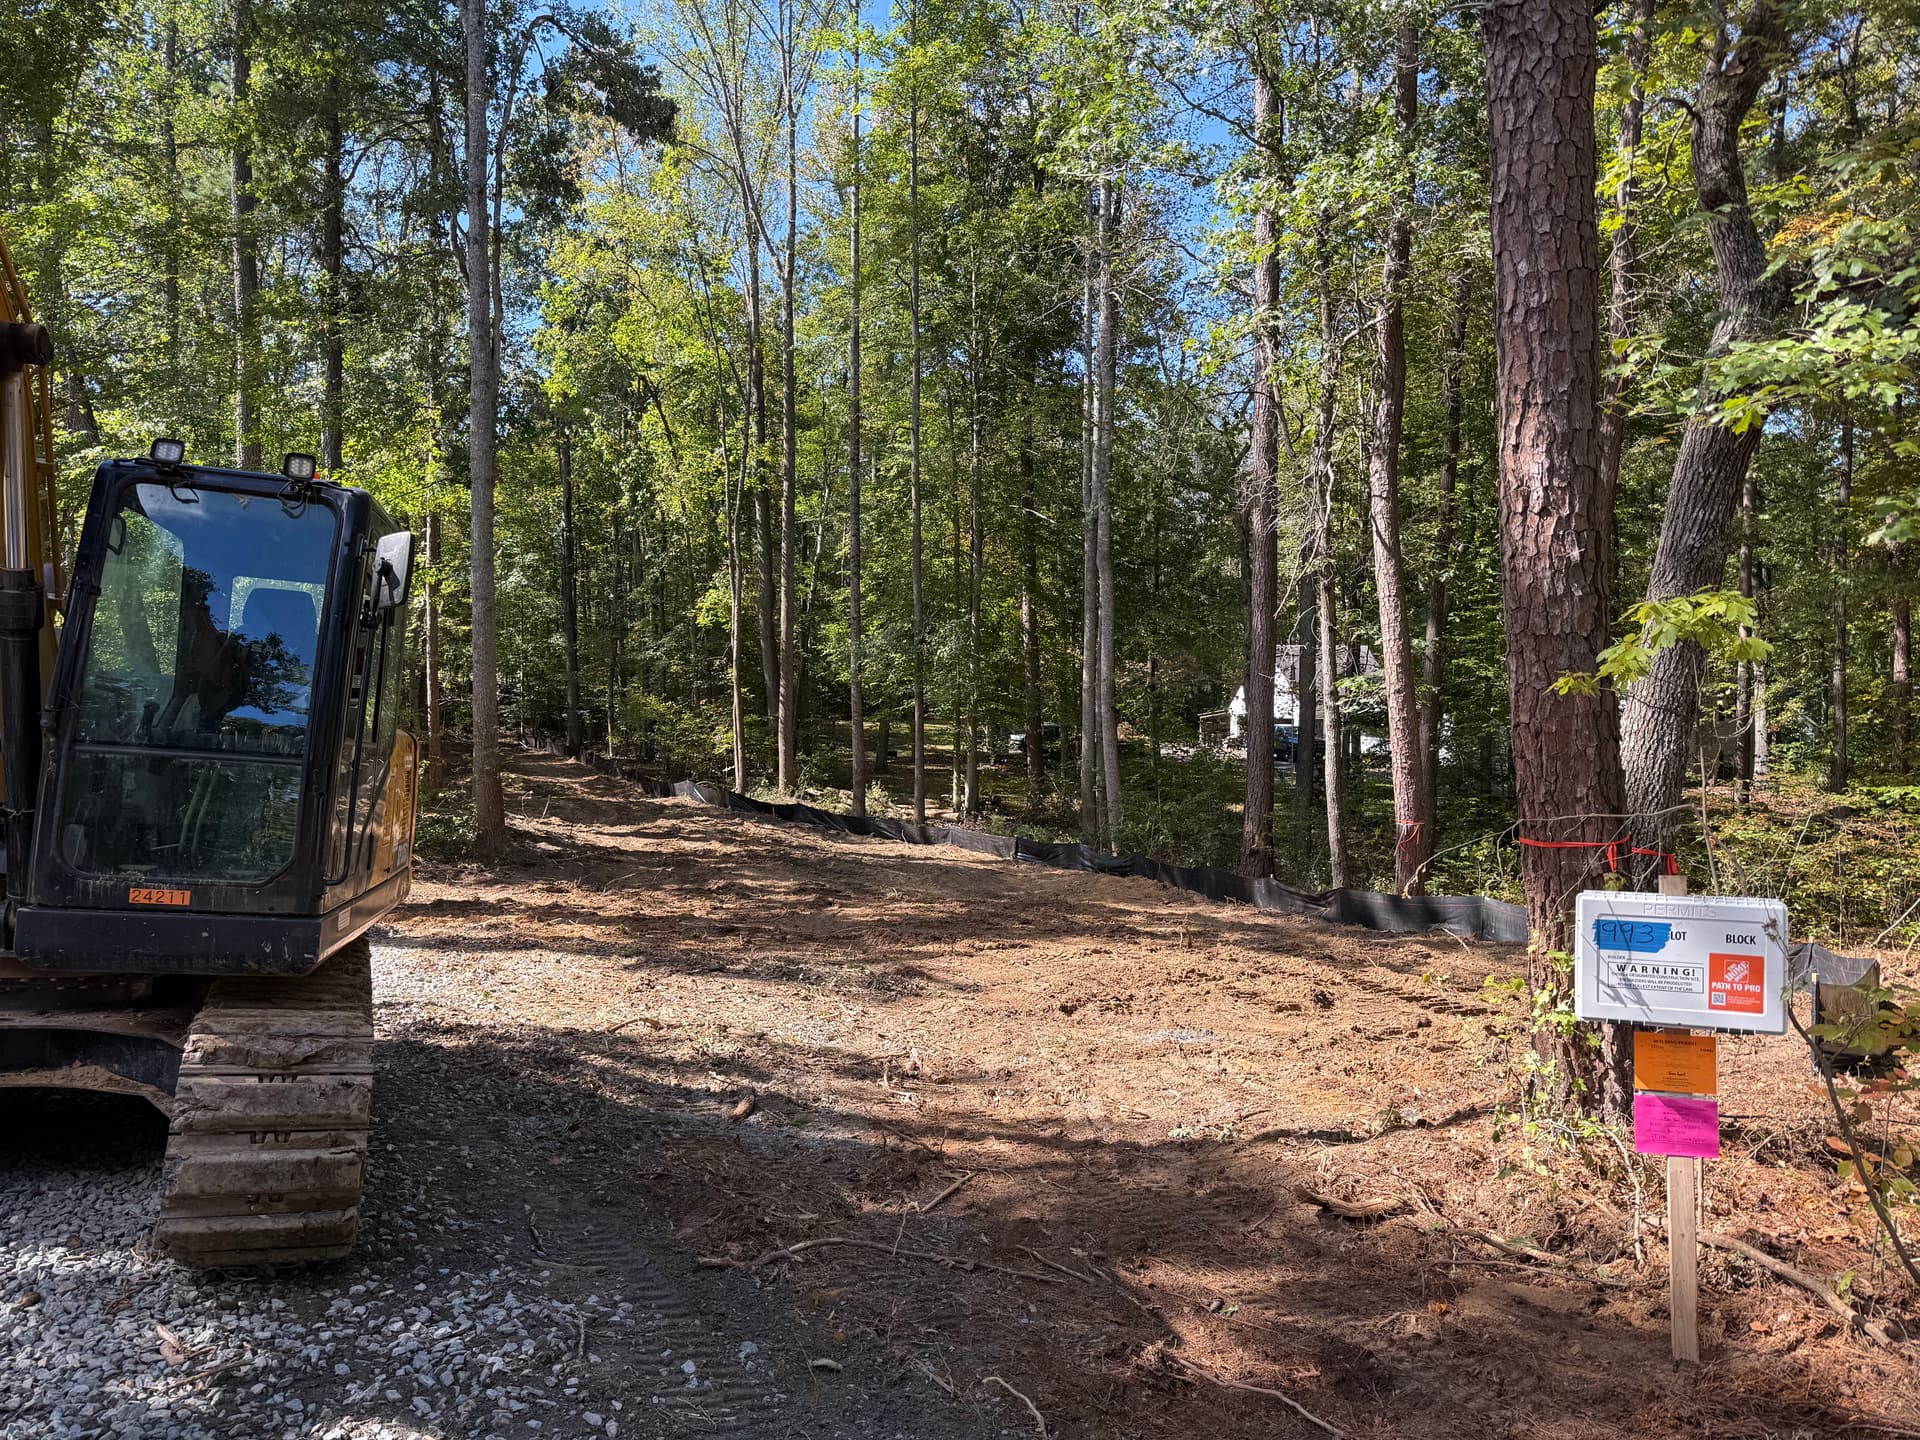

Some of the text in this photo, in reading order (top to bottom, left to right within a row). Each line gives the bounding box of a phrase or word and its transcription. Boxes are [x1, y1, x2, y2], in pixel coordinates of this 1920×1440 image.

[131, 890, 185, 904] 24211
[1643, 903, 1716, 918] PERMITS
[1602, 921, 1654, 943] 993
[1670, 931, 1756, 945] LOT BLOCK
[1616, 964, 1695, 976] WARNING!
[1712, 982, 1760, 993] PATH TO PRO
